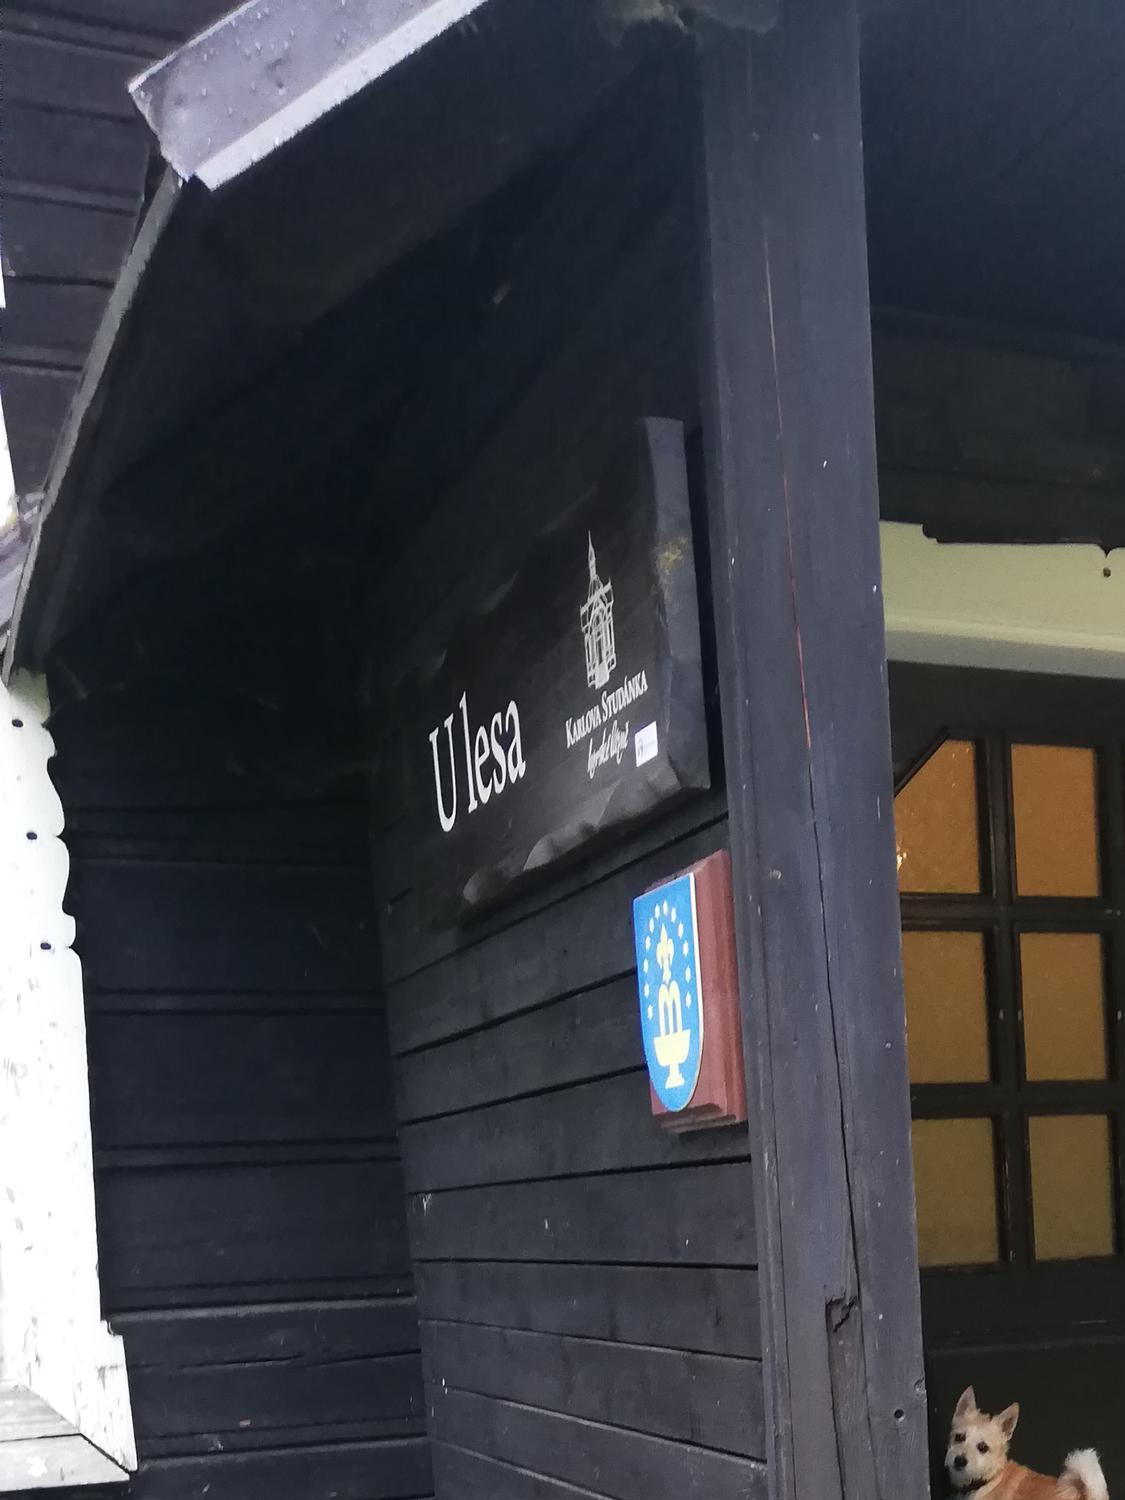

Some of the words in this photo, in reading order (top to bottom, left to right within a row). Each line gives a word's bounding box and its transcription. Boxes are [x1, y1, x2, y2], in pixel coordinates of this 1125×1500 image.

[429, 712, 457, 832] U
[459, 690, 527, 814] lesa
[565, 704, 602, 749] KARLOVA
[601, 669, 649, 723] STUDÁNKA
